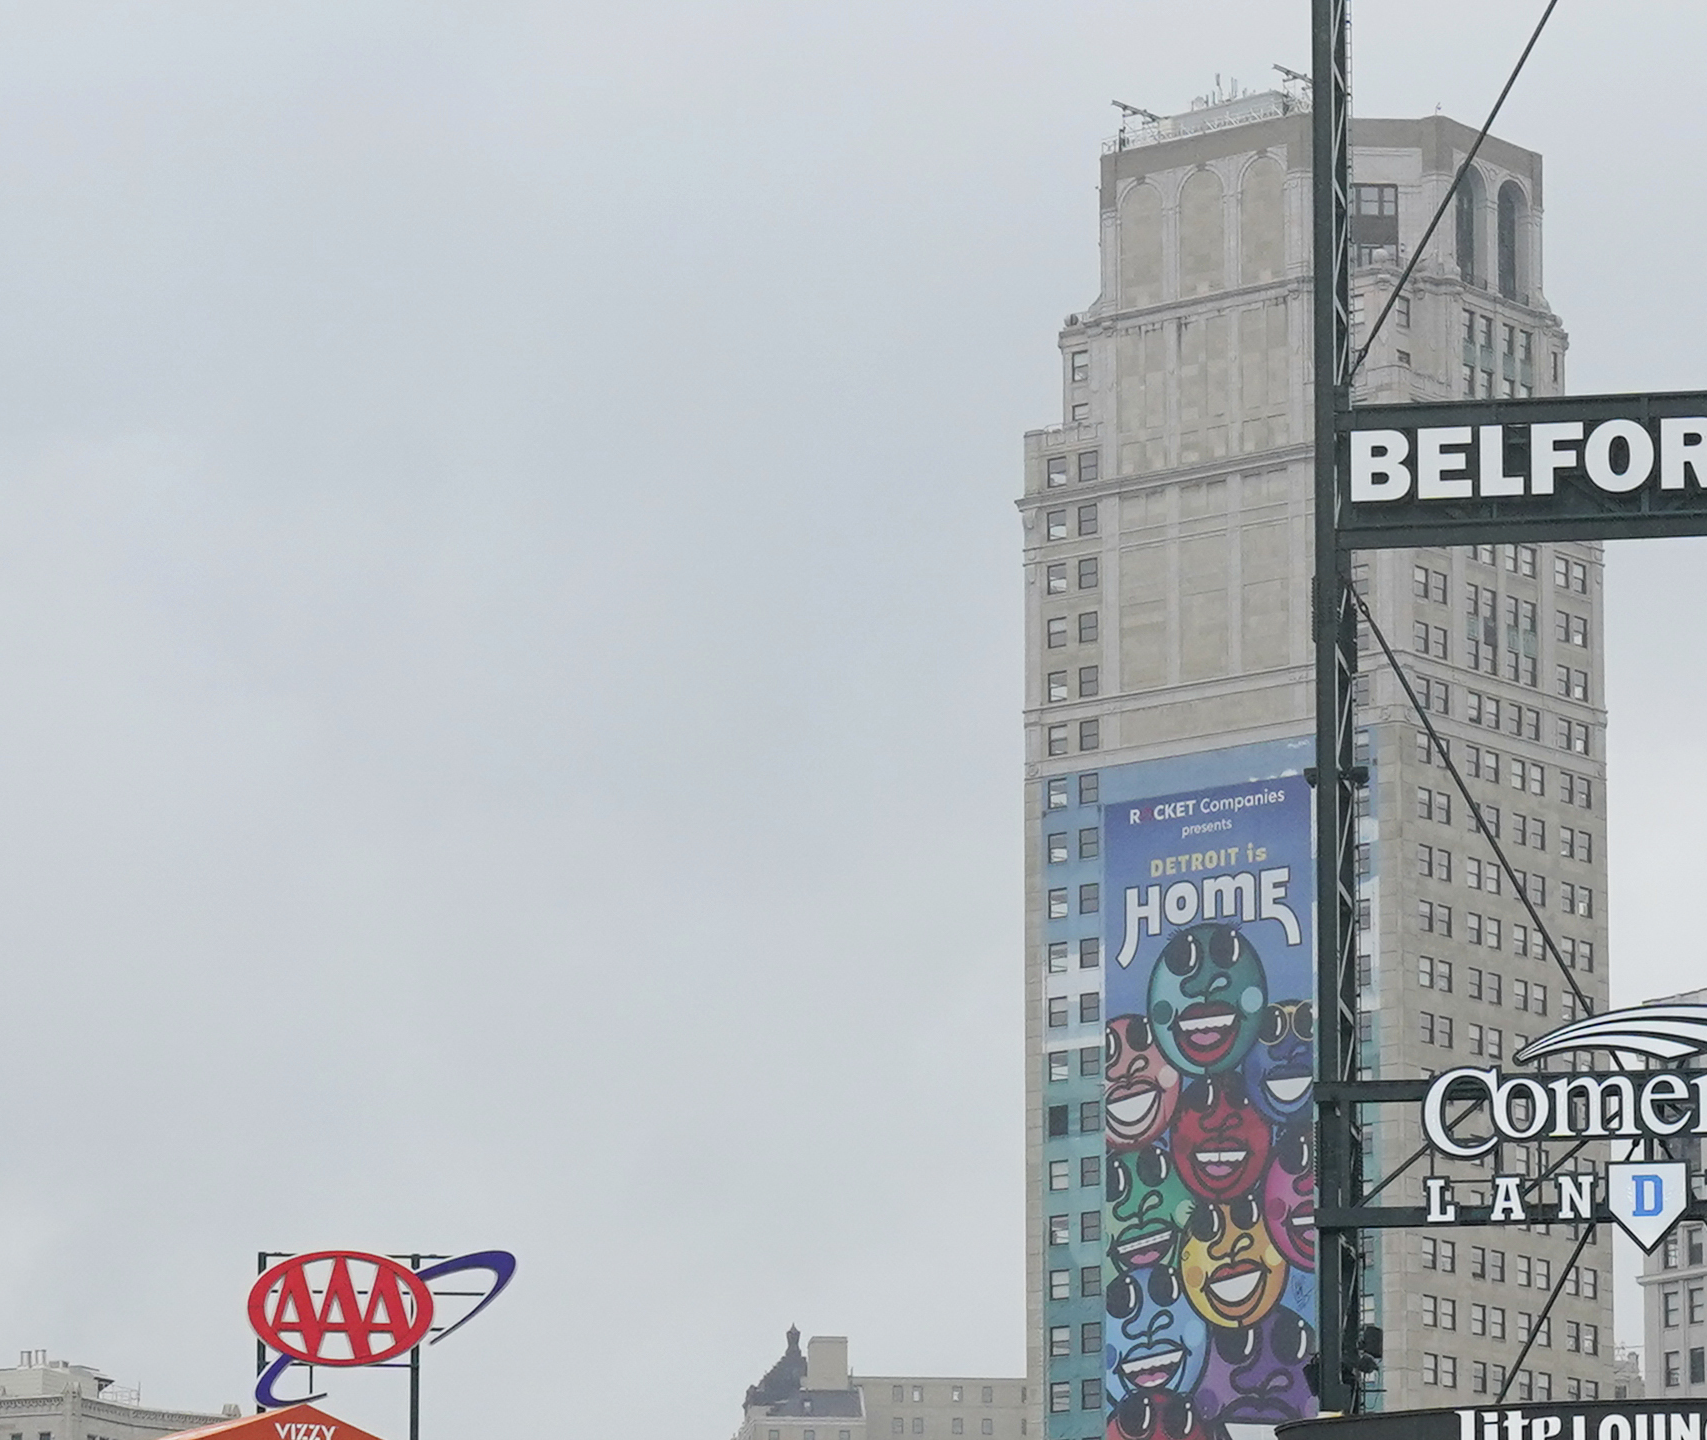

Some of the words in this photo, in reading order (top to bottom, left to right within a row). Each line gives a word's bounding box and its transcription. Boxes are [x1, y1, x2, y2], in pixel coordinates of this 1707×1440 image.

[1130, 800, 1197, 825] ROCKET
[1199, 788, 1286, 814] Companies
[1181, 817, 1233, 838] presents
[1150, 847, 1240, 878] DETROIT
[1246, 842, 1268, 863] is
[271, 1259, 414, 1361] AAA
